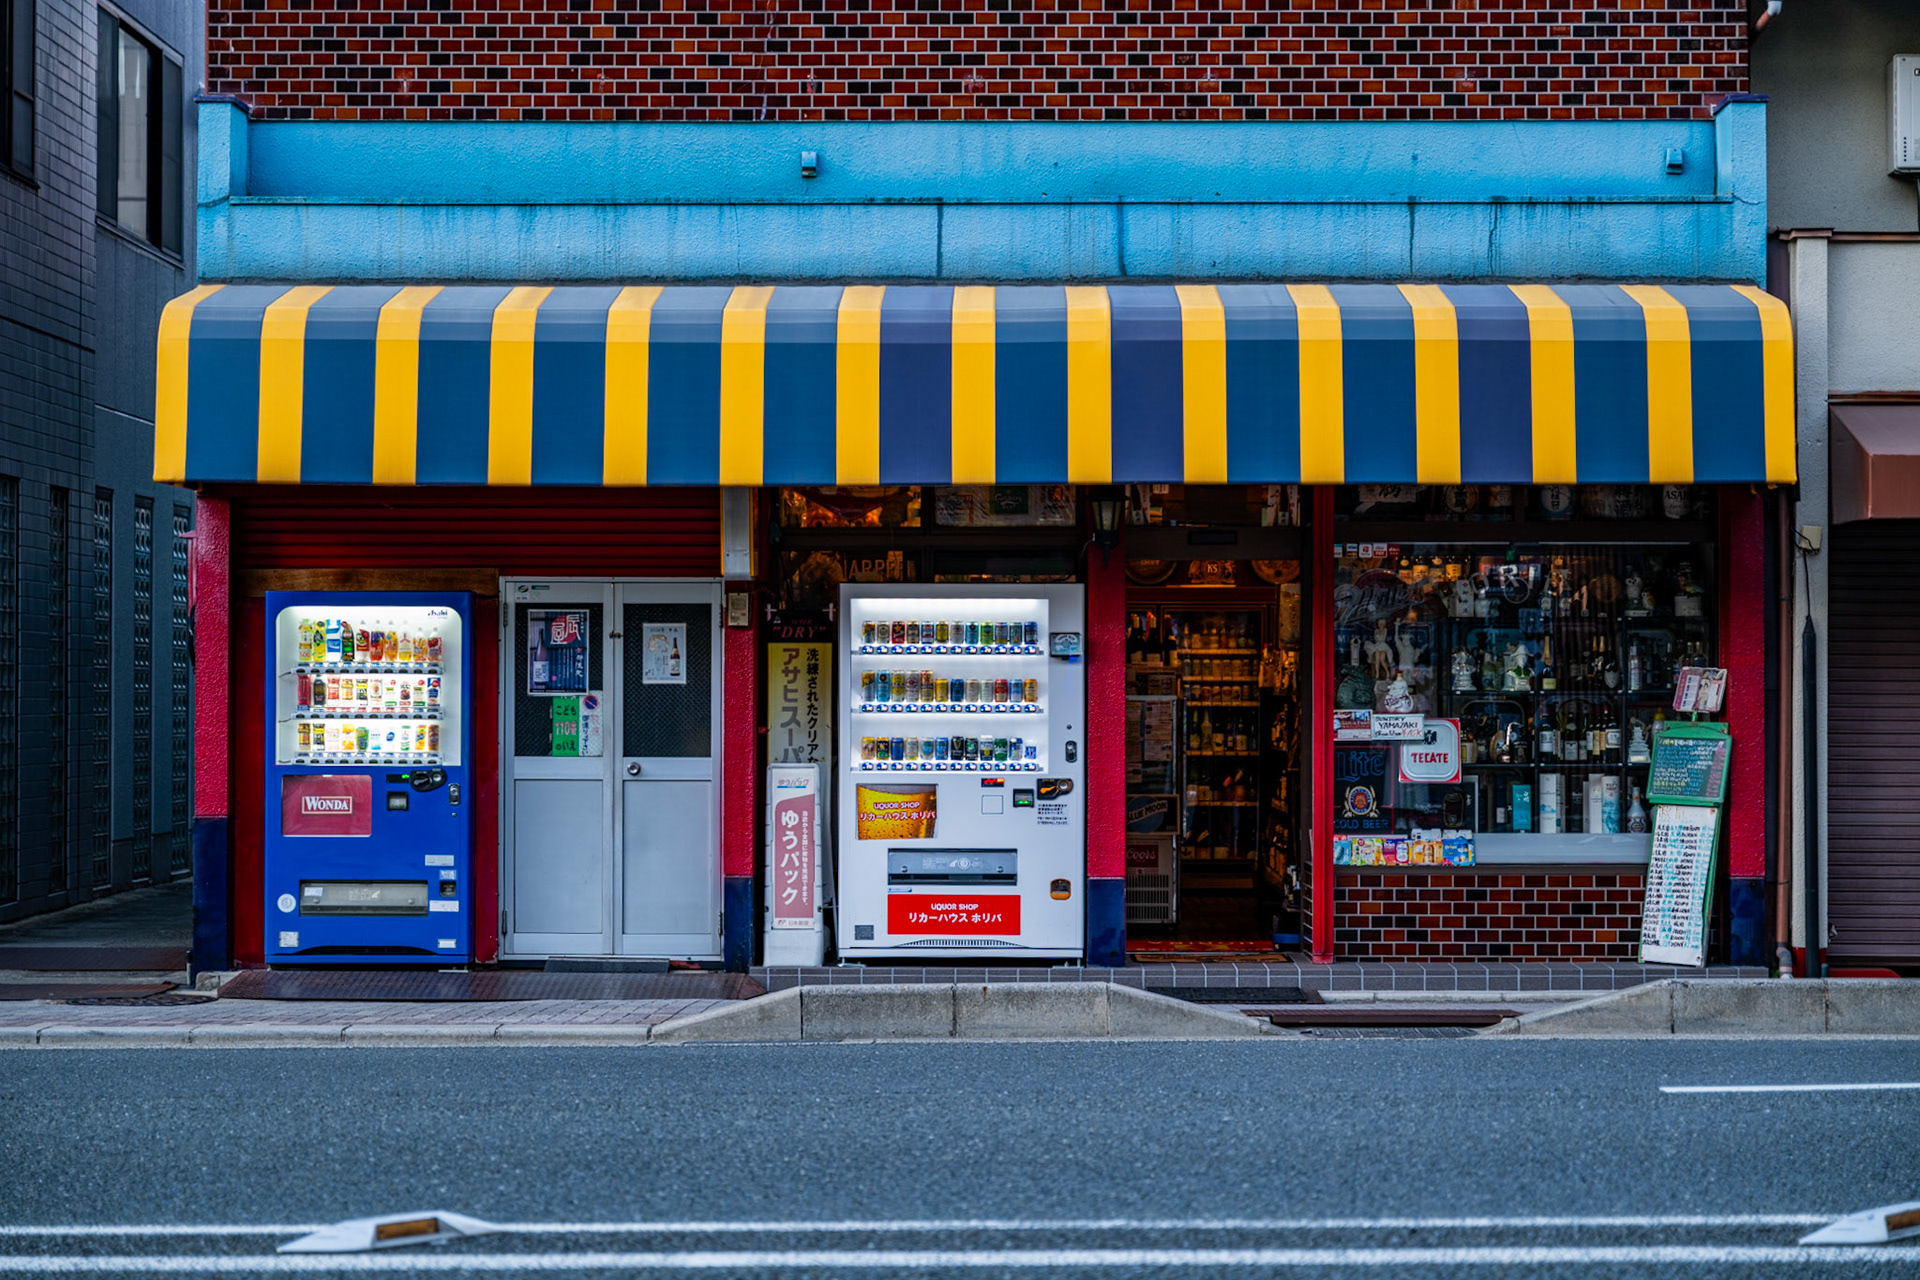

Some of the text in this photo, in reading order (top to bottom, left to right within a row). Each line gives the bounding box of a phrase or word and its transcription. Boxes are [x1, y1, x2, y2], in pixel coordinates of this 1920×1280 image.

[555, 705, 577, 716] こども
[554, 720, 577, 736] 110番
[1378, 722, 1418, 730] YAMAZAKI
[1410, 752, 1449, 764] TECATE
[305, 796, 349, 811] WONDA
[901, 801, 920, 809] SHOP
[859, 811, 937, 821] リカーハウス ホリバ
[1362, 818, 1389, 829] BEER
[780, 810, 800, 906] ゆうパック
[909, 912, 1002, 923] リカーハウス ホリバ
